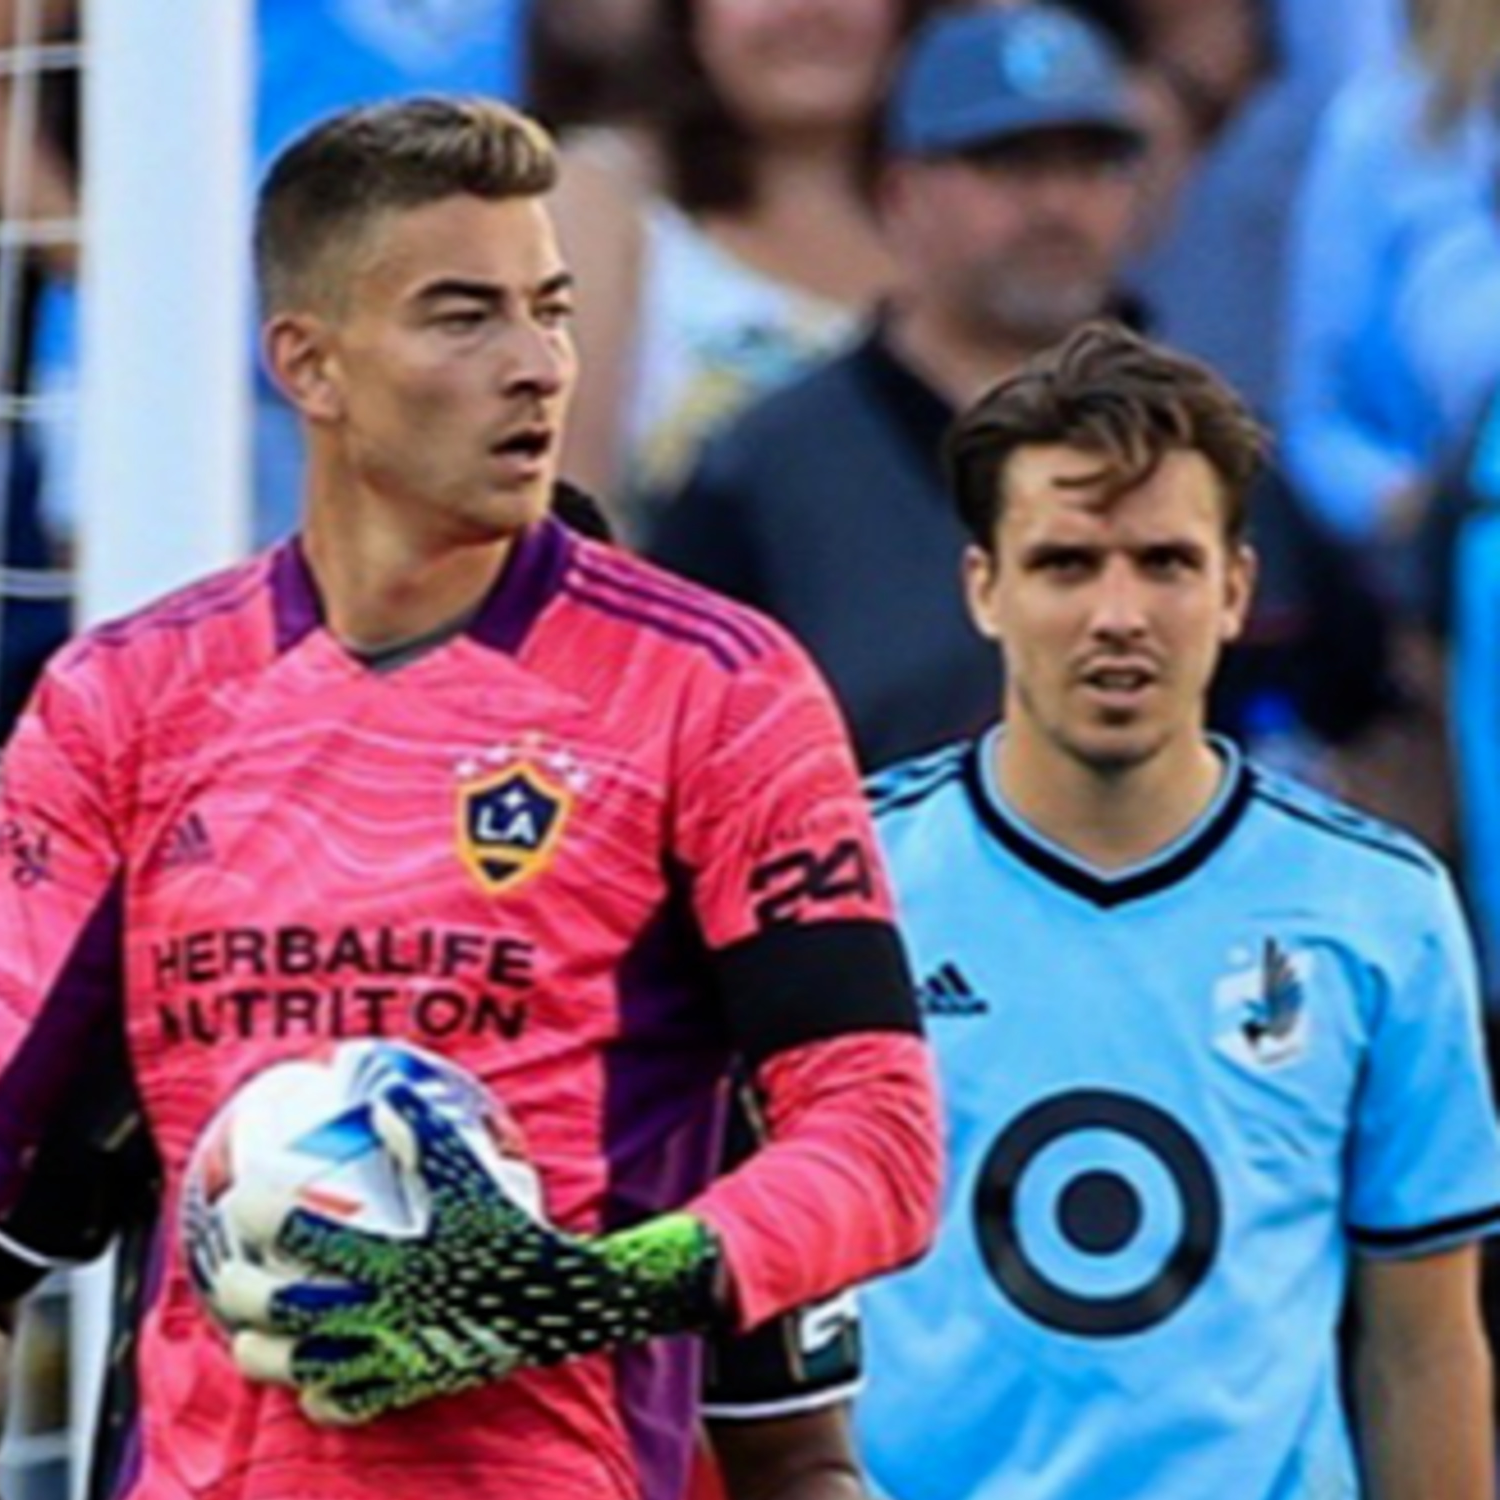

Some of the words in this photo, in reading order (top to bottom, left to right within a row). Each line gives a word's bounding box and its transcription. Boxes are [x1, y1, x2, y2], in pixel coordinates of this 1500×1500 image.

[476, 805, 538, 847] LA
[152, 925, 534, 991] HERBALIFE
[155, 986, 526, 1046] NUTRITON
